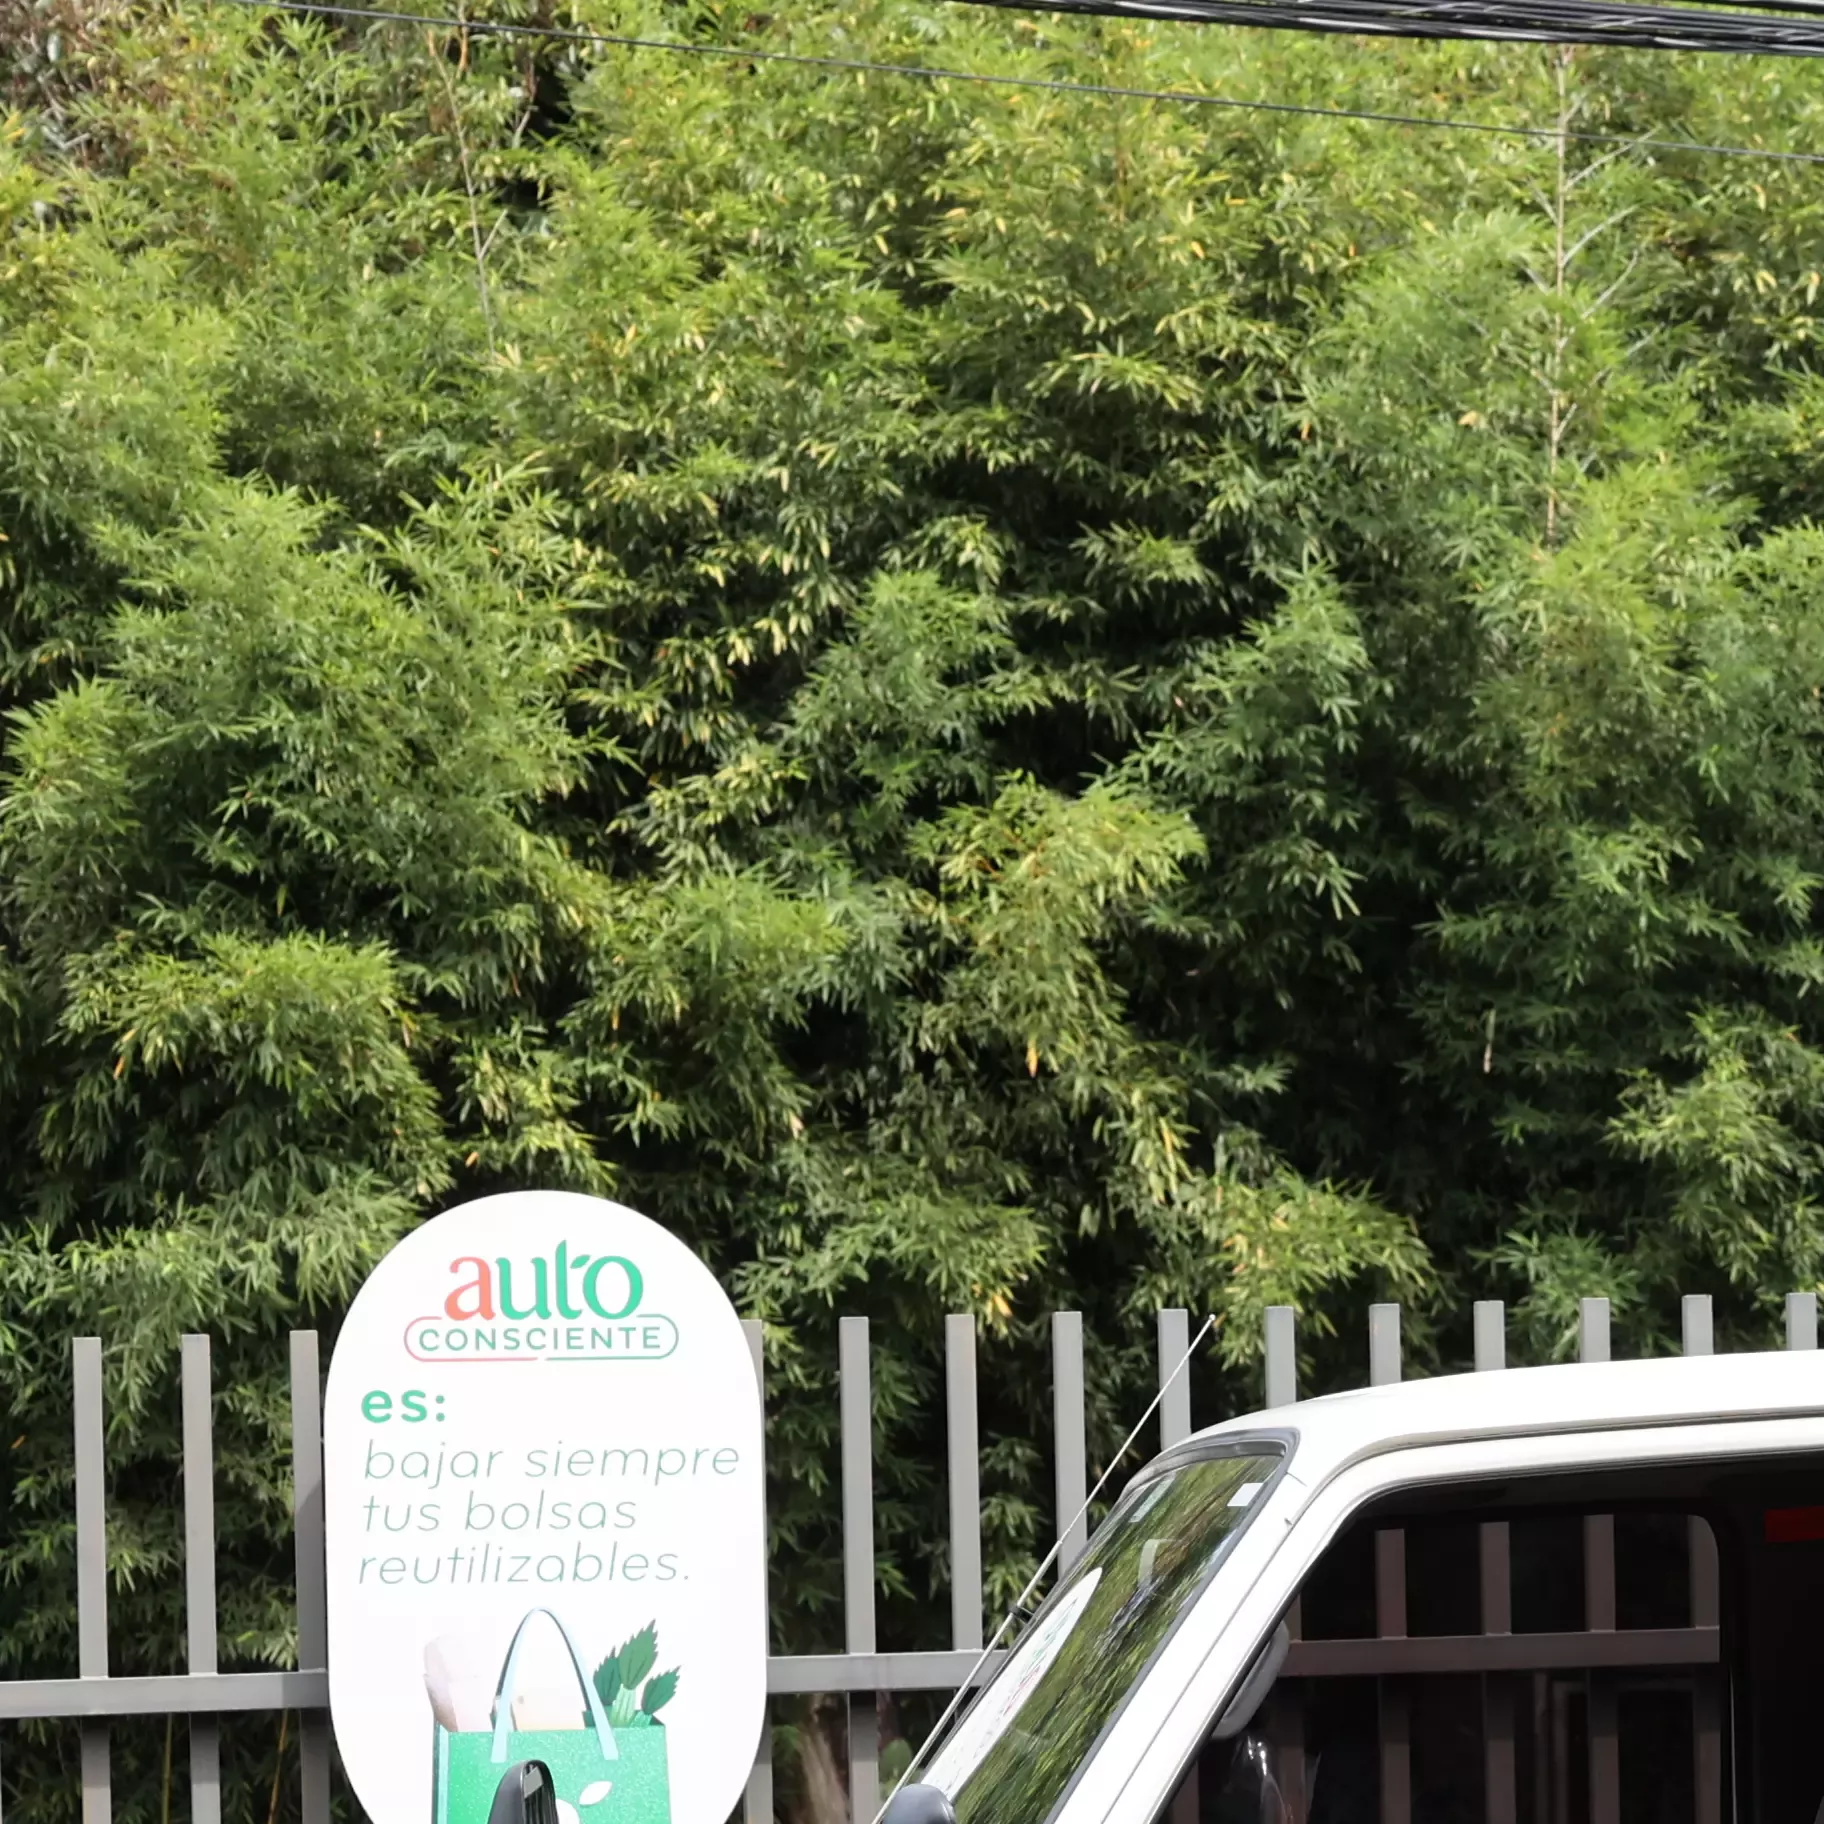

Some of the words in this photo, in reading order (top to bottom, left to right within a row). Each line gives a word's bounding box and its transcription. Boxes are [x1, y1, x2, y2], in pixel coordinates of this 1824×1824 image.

[444, 1240, 644, 1322] auto
[418, 1325, 662, 1352] CONSCIENTE
[361, 1389, 447, 1424] es:
[365, 1439, 504, 1490] bajar
[525, 1441, 740, 1487] siempre
[362, 1495, 440, 1533] tus
[465, 1490, 637, 1531] bolsas
[358, 1541, 690, 1586] reutilizables.
